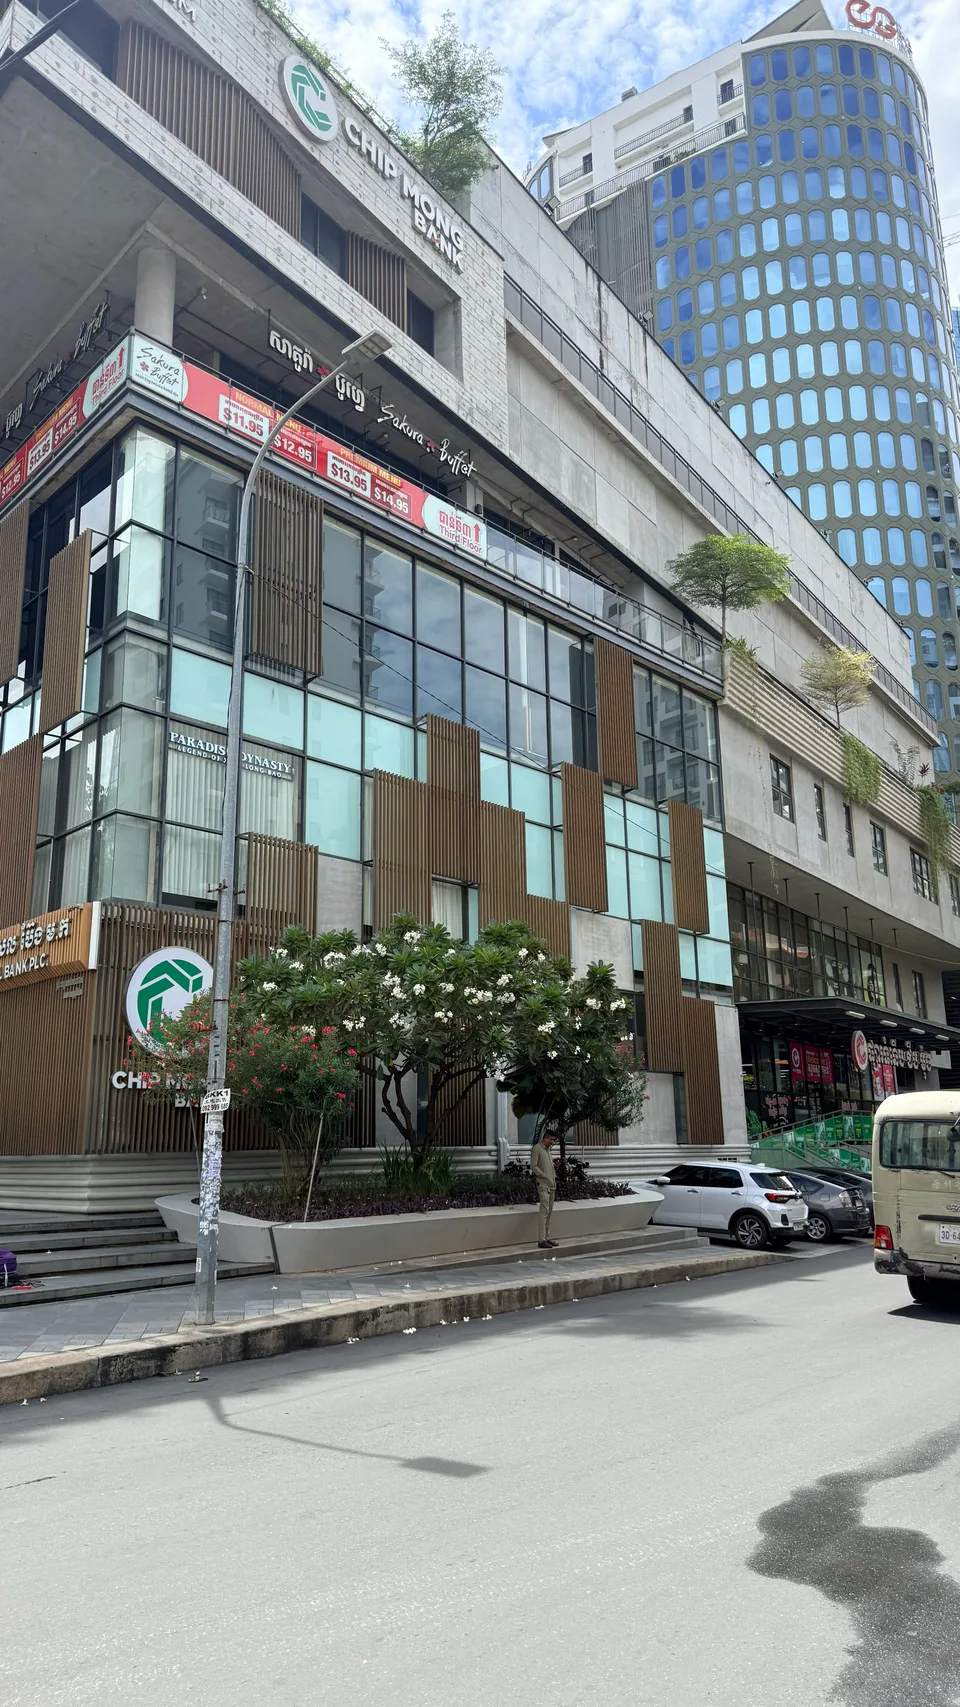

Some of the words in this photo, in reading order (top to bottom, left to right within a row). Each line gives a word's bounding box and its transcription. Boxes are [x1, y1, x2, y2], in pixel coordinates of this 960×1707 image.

[344, 117, 398, 179] CHIP
[402, 172, 465, 252] MONG
[413, 207, 465, 275] BANK
[73, 301, 109, 359] Buffet
[136, 346, 180, 376] Sakura
[91, 387, 108, 406] Third
[108, 367, 125, 388] Floor
[149, 366, 180, 387] Buffet
[235, 391, 274, 418] NORMAL
[54, 412, 77, 445] $14.95
[223, 407, 264, 438] $11.95
[273, 433, 313, 463] $12.95
[377, 403, 424, 445] Sakura
[439, 438, 478, 478] Buffet
[29, 441, 51, 471] $13.95
[340, 448, 378, 474] PREMIUM
[378, 468, 401, 487] MENU
[1, 472, 21, 500] $12.95
[331, 462, 368, 492] $13.95
[374, 486, 409, 514] $14.95
[439, 525, 460, 543] Third
[462, 536, 482, 553] Floor
[170, 731, 228, 756] PARADIS
[177, 745, 208, 759] LEGEND
[245, 763, 264, 774] LONG
[267, 769, 282, 778] BAO
[4, 959, 27, 979] BANK
[28, 952, 48, 972] PLC.
